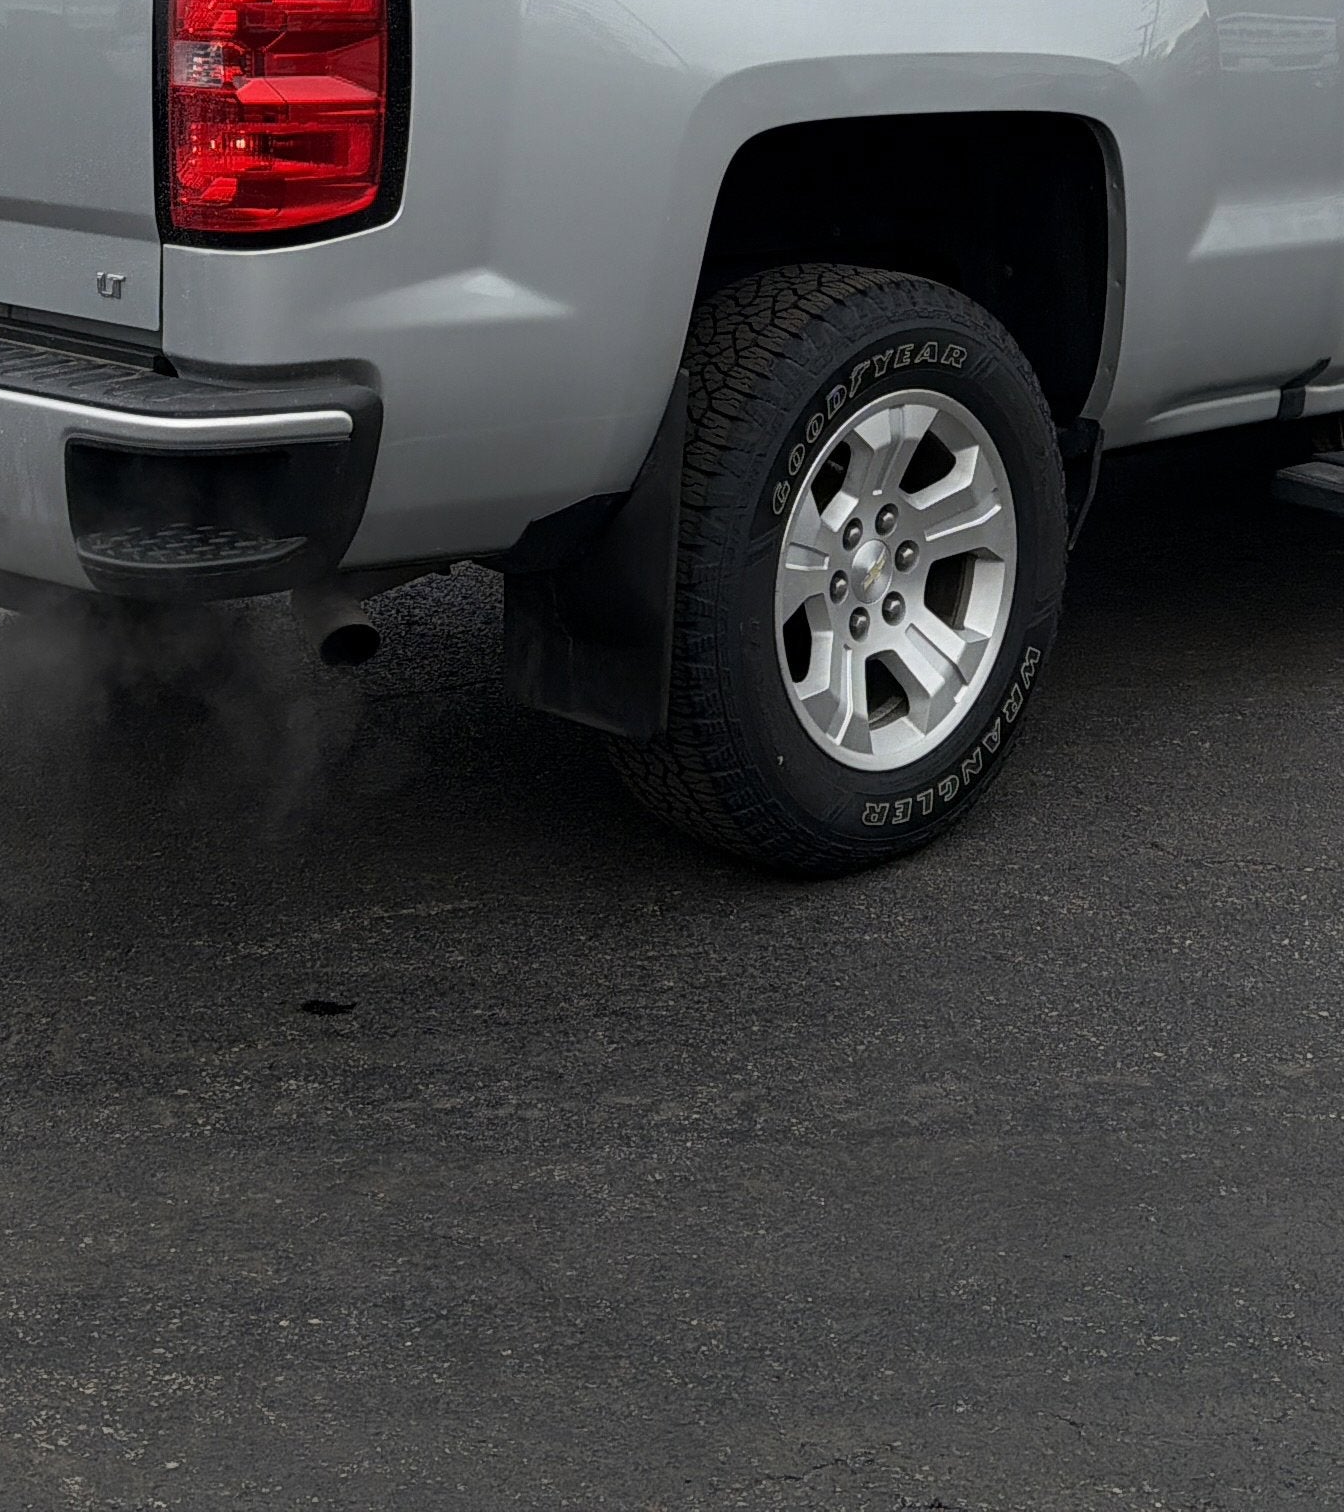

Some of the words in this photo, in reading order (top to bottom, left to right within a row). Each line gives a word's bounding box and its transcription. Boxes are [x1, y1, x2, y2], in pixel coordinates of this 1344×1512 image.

[96, 271, 126, 300] LT
[772, 341, 968, 516] GOODYEAR
[862, 646, 1042, 826] WRANGLER
